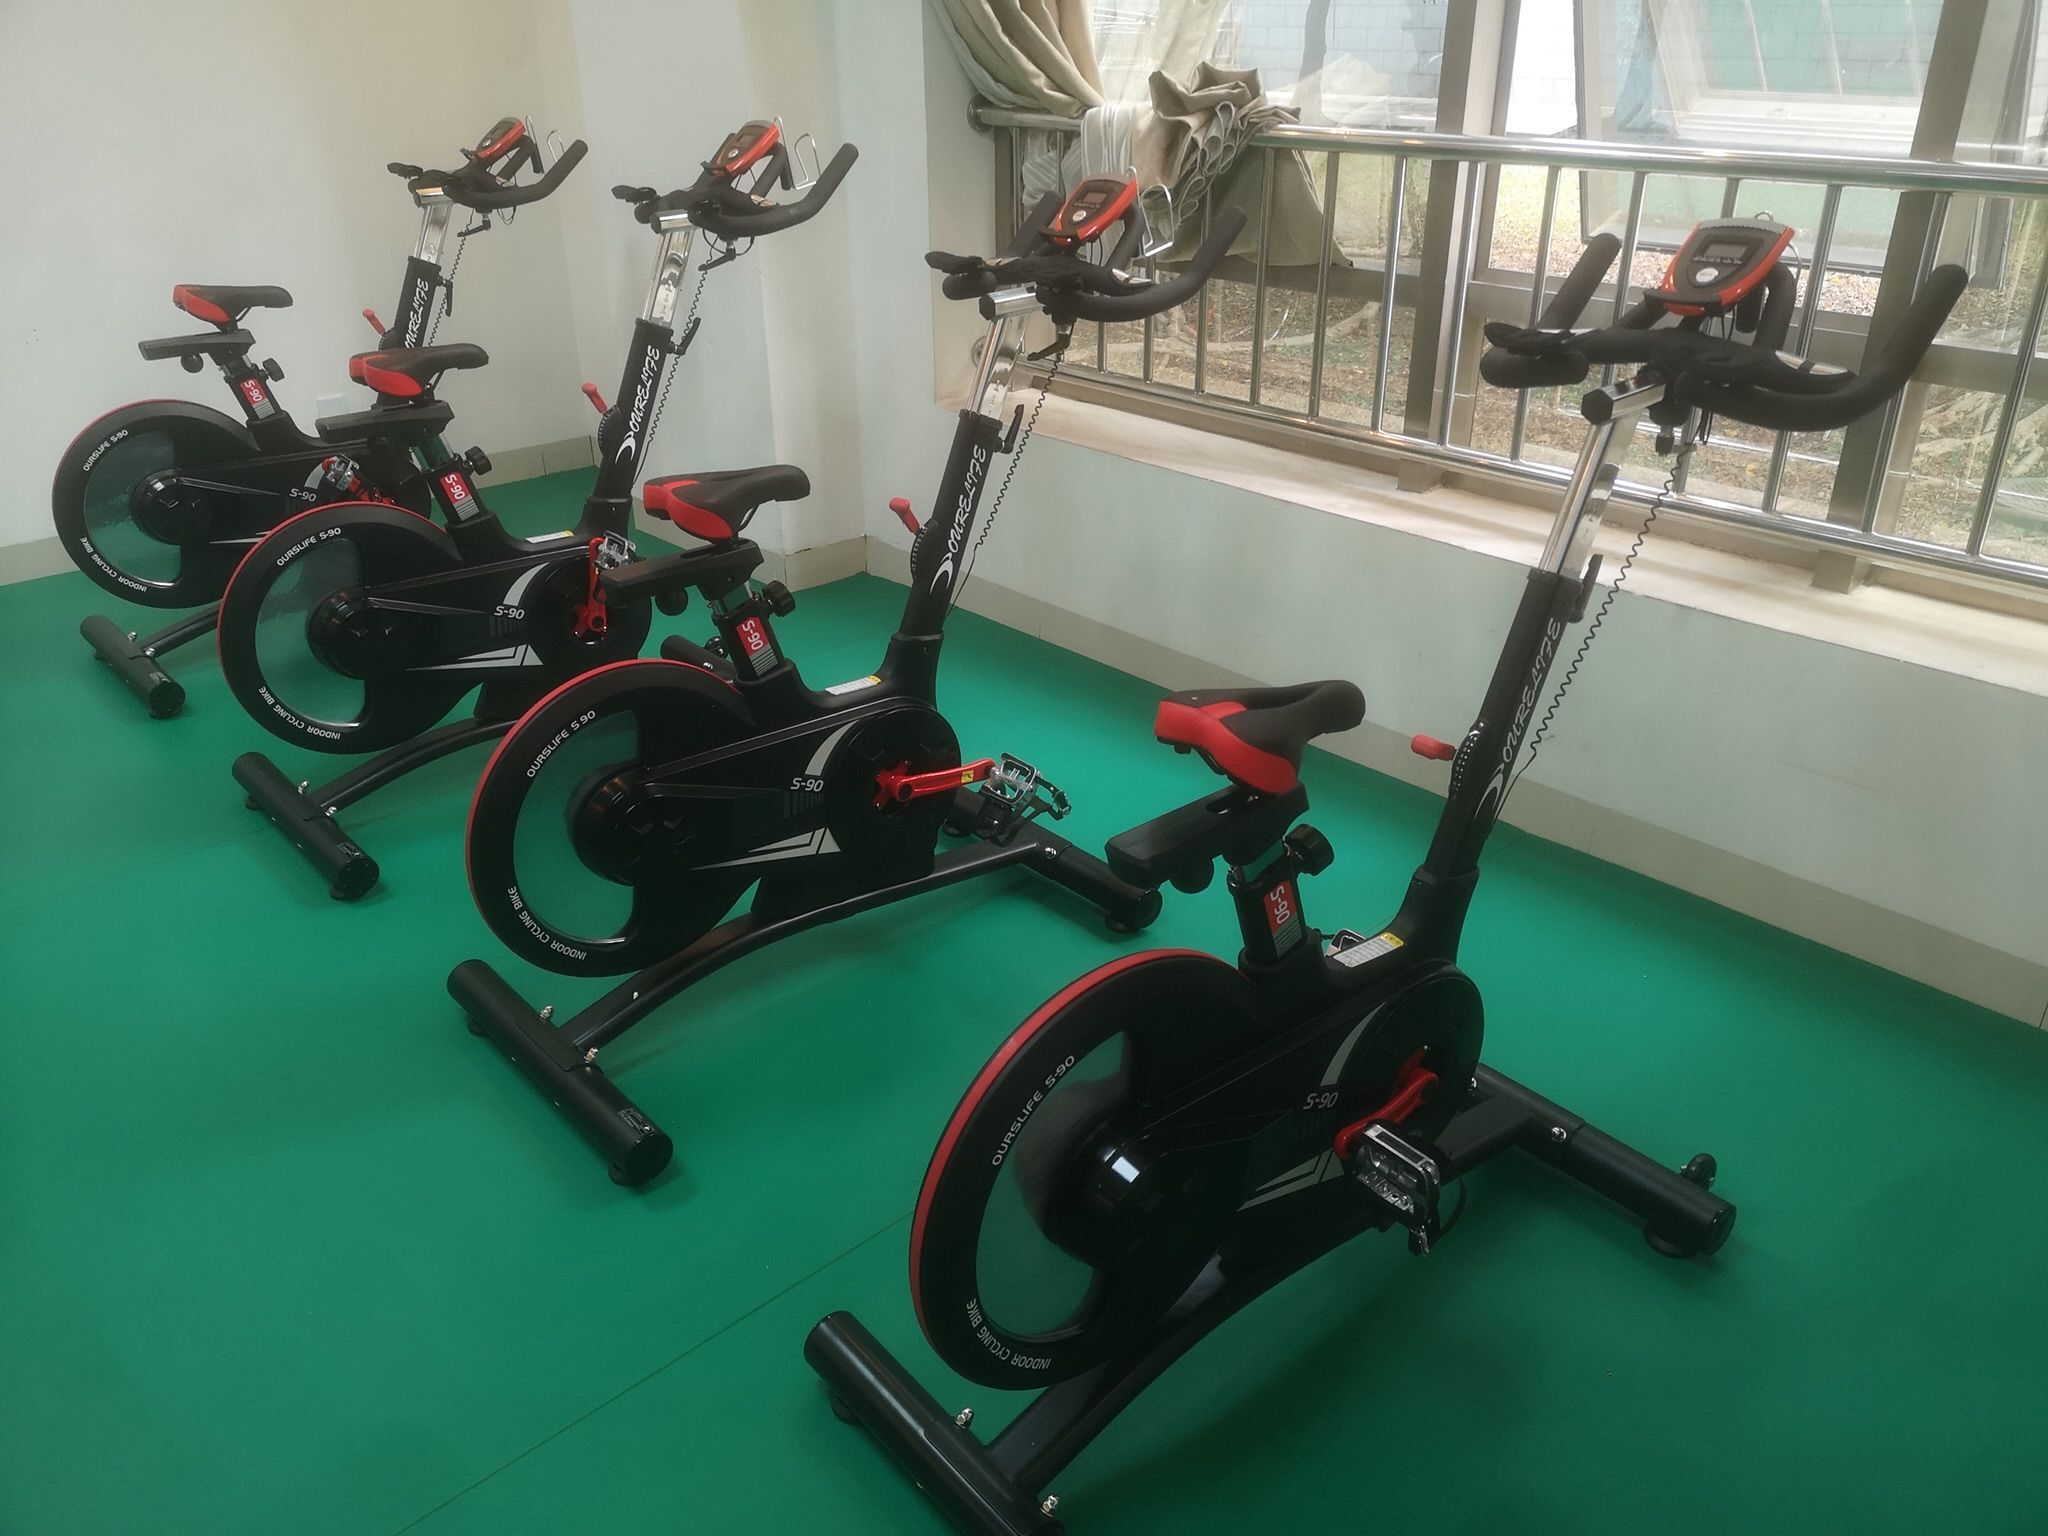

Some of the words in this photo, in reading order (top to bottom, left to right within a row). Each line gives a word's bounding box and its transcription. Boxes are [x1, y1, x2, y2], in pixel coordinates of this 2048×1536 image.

[244, 380, 263, 401] S-90
[83, 440, 111, 471] OURSLIFE
[289, 488, 317, 502] S-90
[445, 474, 465, 500] S-90
[80, 536, 94, 553] BIKE
[276, 535, 317, 566] OURSLIFE
[319, 527, 341, 540] S-90
[91, 554, 117, 578] CYCLING
[118, 576, 148, 592] INDOOR
[493, 605, 525, 620] S-90
[741, 619, 764, 651] S-90
[258, 686, 275, 705] BIKE
[273, 704, 305, 729] CYCLING
[306, 725, 341, 740] INDOOR
[526, 729, 570, 778] OURSLIFE
[790, 777, 824, 792] S-90
[507, 886, 523, 910] BIKE
[1270, 885, 1290, 924] S-90
[518, 910, 550, 943] CYCLING
[550, 940, 587, 960] INDOOR
[992, 1090, 1044, 1166] OURSLIFE
[1045, 1055, 1075, 1088] S-90
[1302, 1092, 1339, 1110] S-90
[966, 1298, 983, 1328] BIKE
[976, 1326, 1011, 1360] CYCLING
[1010, 1353, 1052, 1369] INDOOR
